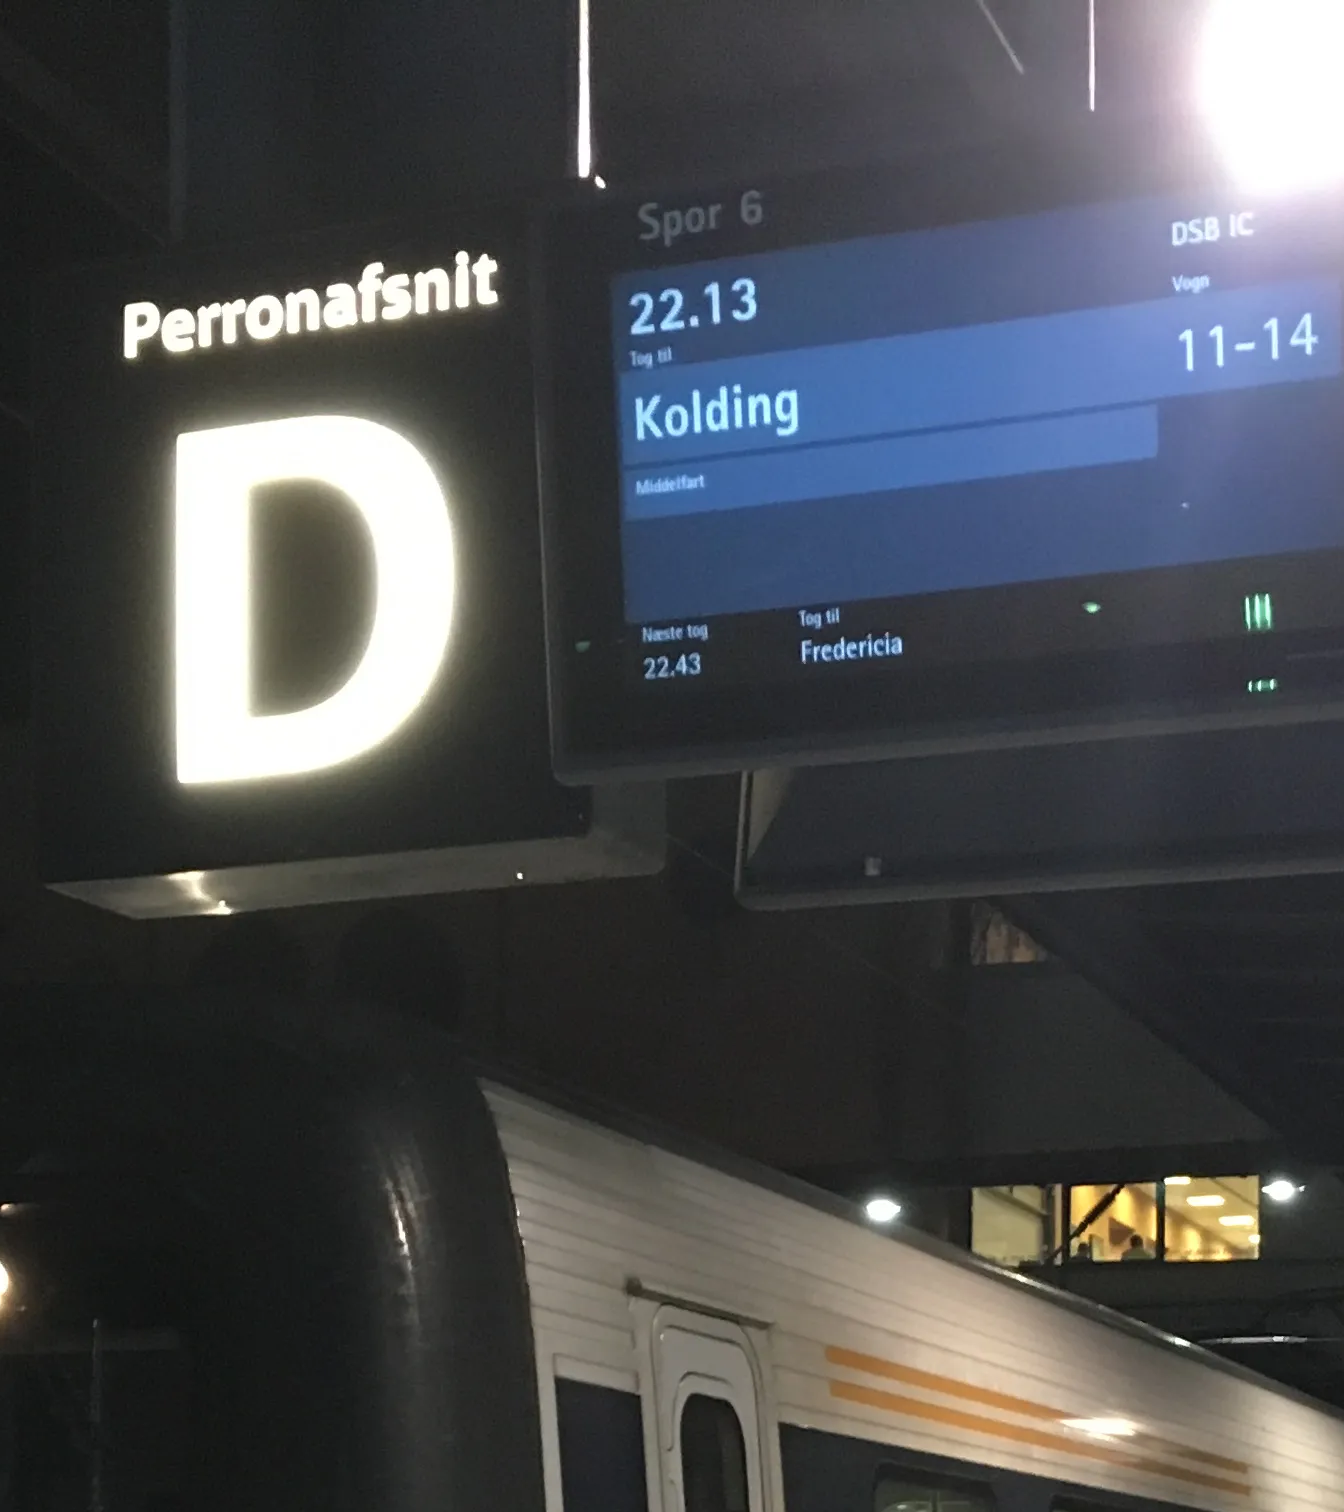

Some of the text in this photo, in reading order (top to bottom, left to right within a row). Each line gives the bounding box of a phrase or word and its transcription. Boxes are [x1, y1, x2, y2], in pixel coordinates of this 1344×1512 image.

[637, 190, 763, 247] Spor 6
[1171, 211, 1255, 247] DSB IC
[1171, 273, 1211, 294] Vogn
[121, 251, 499, 359] Perronafsnit
[628, 277, 757, 336] 22.13
[1178, 311, 1319, 372] 11-14
[629, 350, 654, 369] Tog
[634, 384, 800, 441] Kolding
[635, 474, 706, 497] Middelfart
[175, 415, 457, 784] D
[641, 624, 709, 644] Næste tog
[798, 606, 841, 631] Tog til
[800, 632, 905, 664] Fredericia
[643, 652, 702, 681] 22.43
